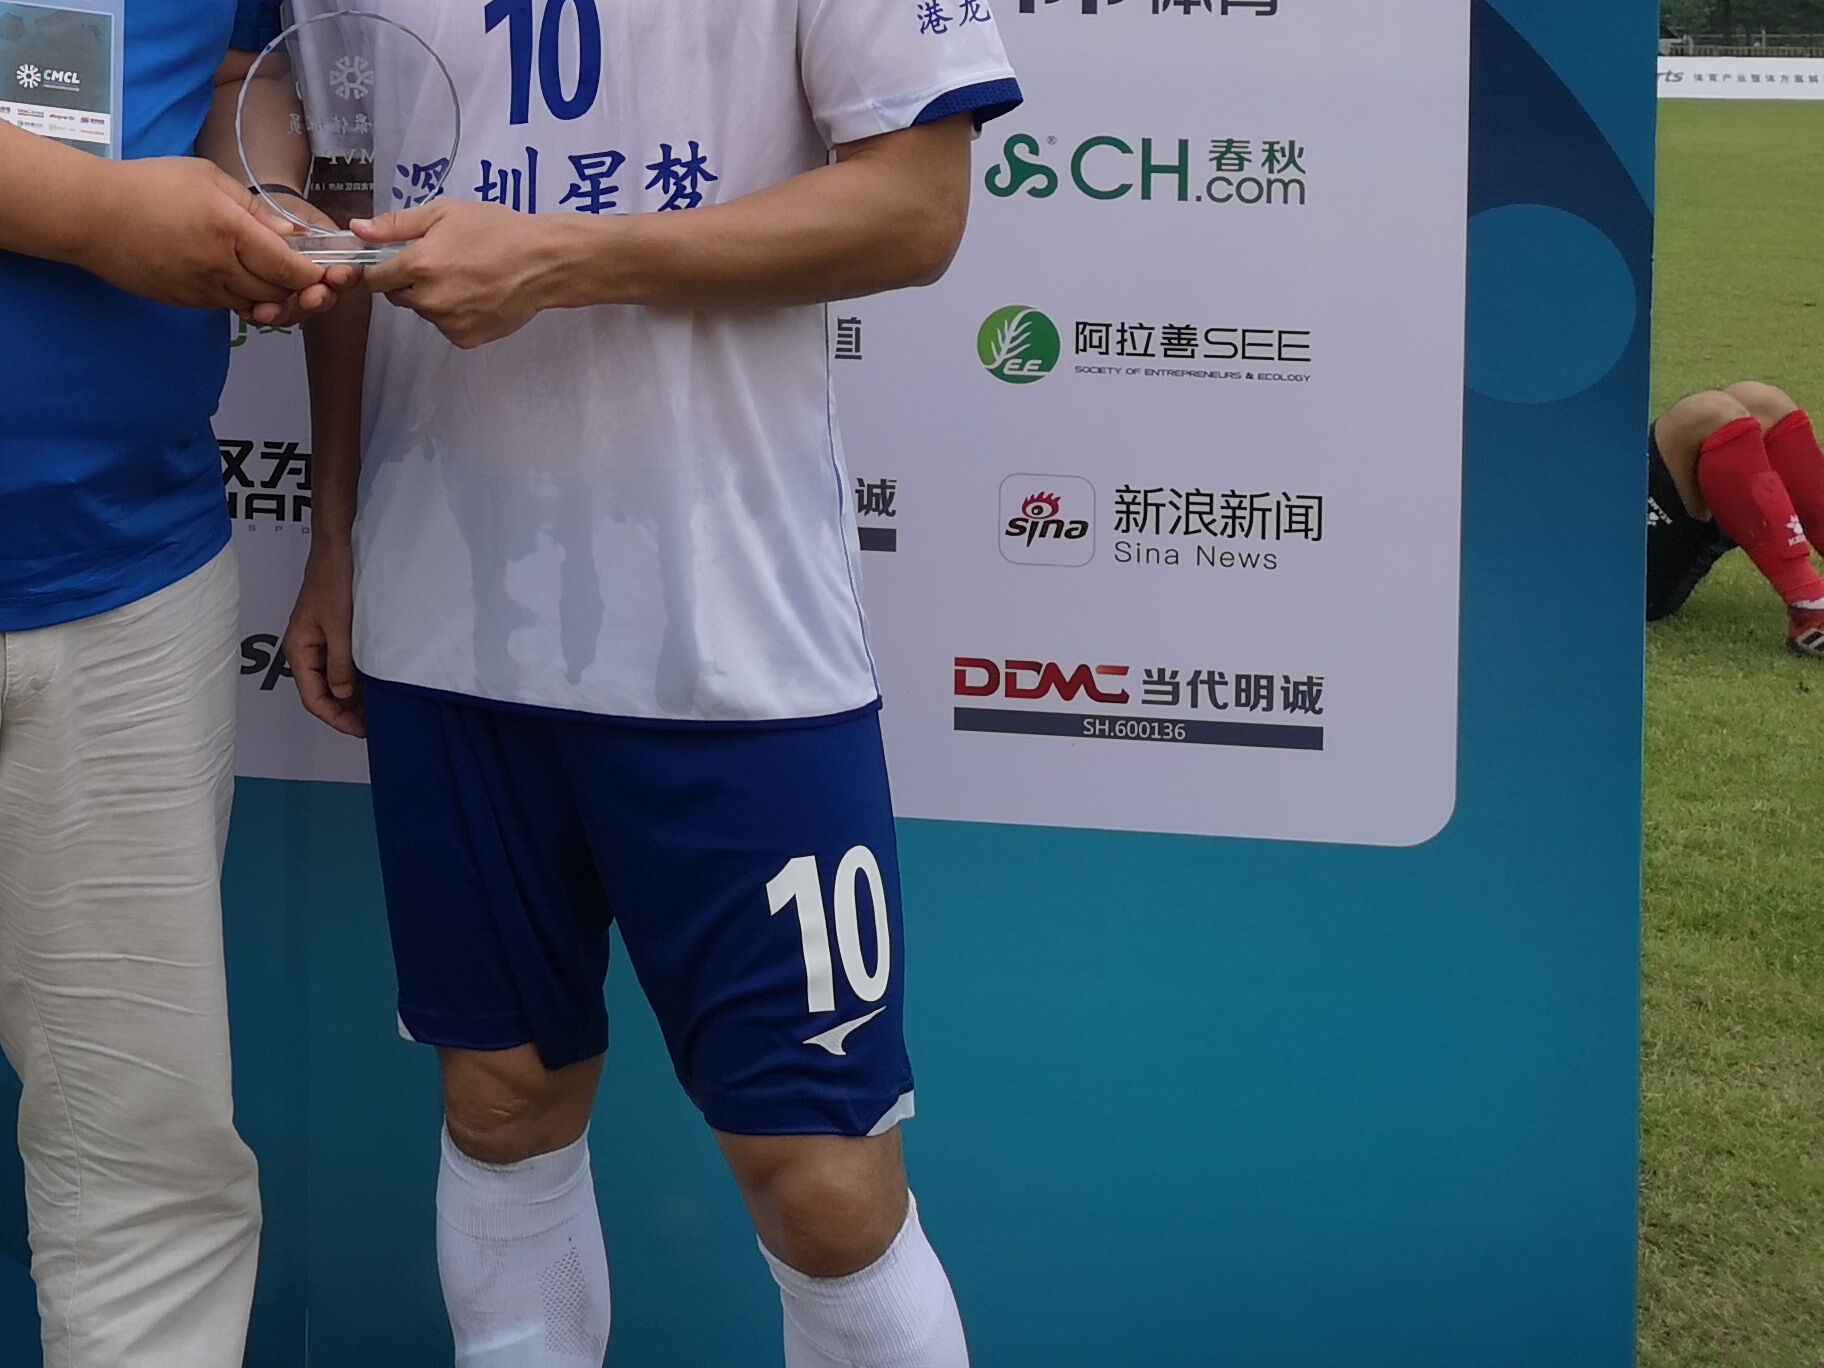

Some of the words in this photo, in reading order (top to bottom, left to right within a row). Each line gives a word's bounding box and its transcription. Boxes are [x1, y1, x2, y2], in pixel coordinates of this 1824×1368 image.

[43, 69, 80, 83] CMCL
[1208, 138, 1306, 175] 春秋
[392, 140, 718, 214] 深圳星梦
[1075, 321, 1312, 362] 阿拉善SEE
[1074, 365, 1122, 375] SOCIETY
[1125, 367, 1142, 375] OF
[1144, 368, 1242, 380] ENTREPRENEURS
[1245, 372, 1254, 380] &
[1257, 372, 1312, 382] ECOLOGY
[1005, 516, 1089, 548] sina
[1114, 484, 1323, 543] 新浪新闻
[1114, 541, 1179, 566] Sina
[1196, 545, 1277, 570] News
[954, 656, 1130, 704] DDMC
[1141, 666, 1325, 715] 当代明诚
[1082, 718, 1187, 740] SH.600136
[766, 845, 891, 1013] 10
